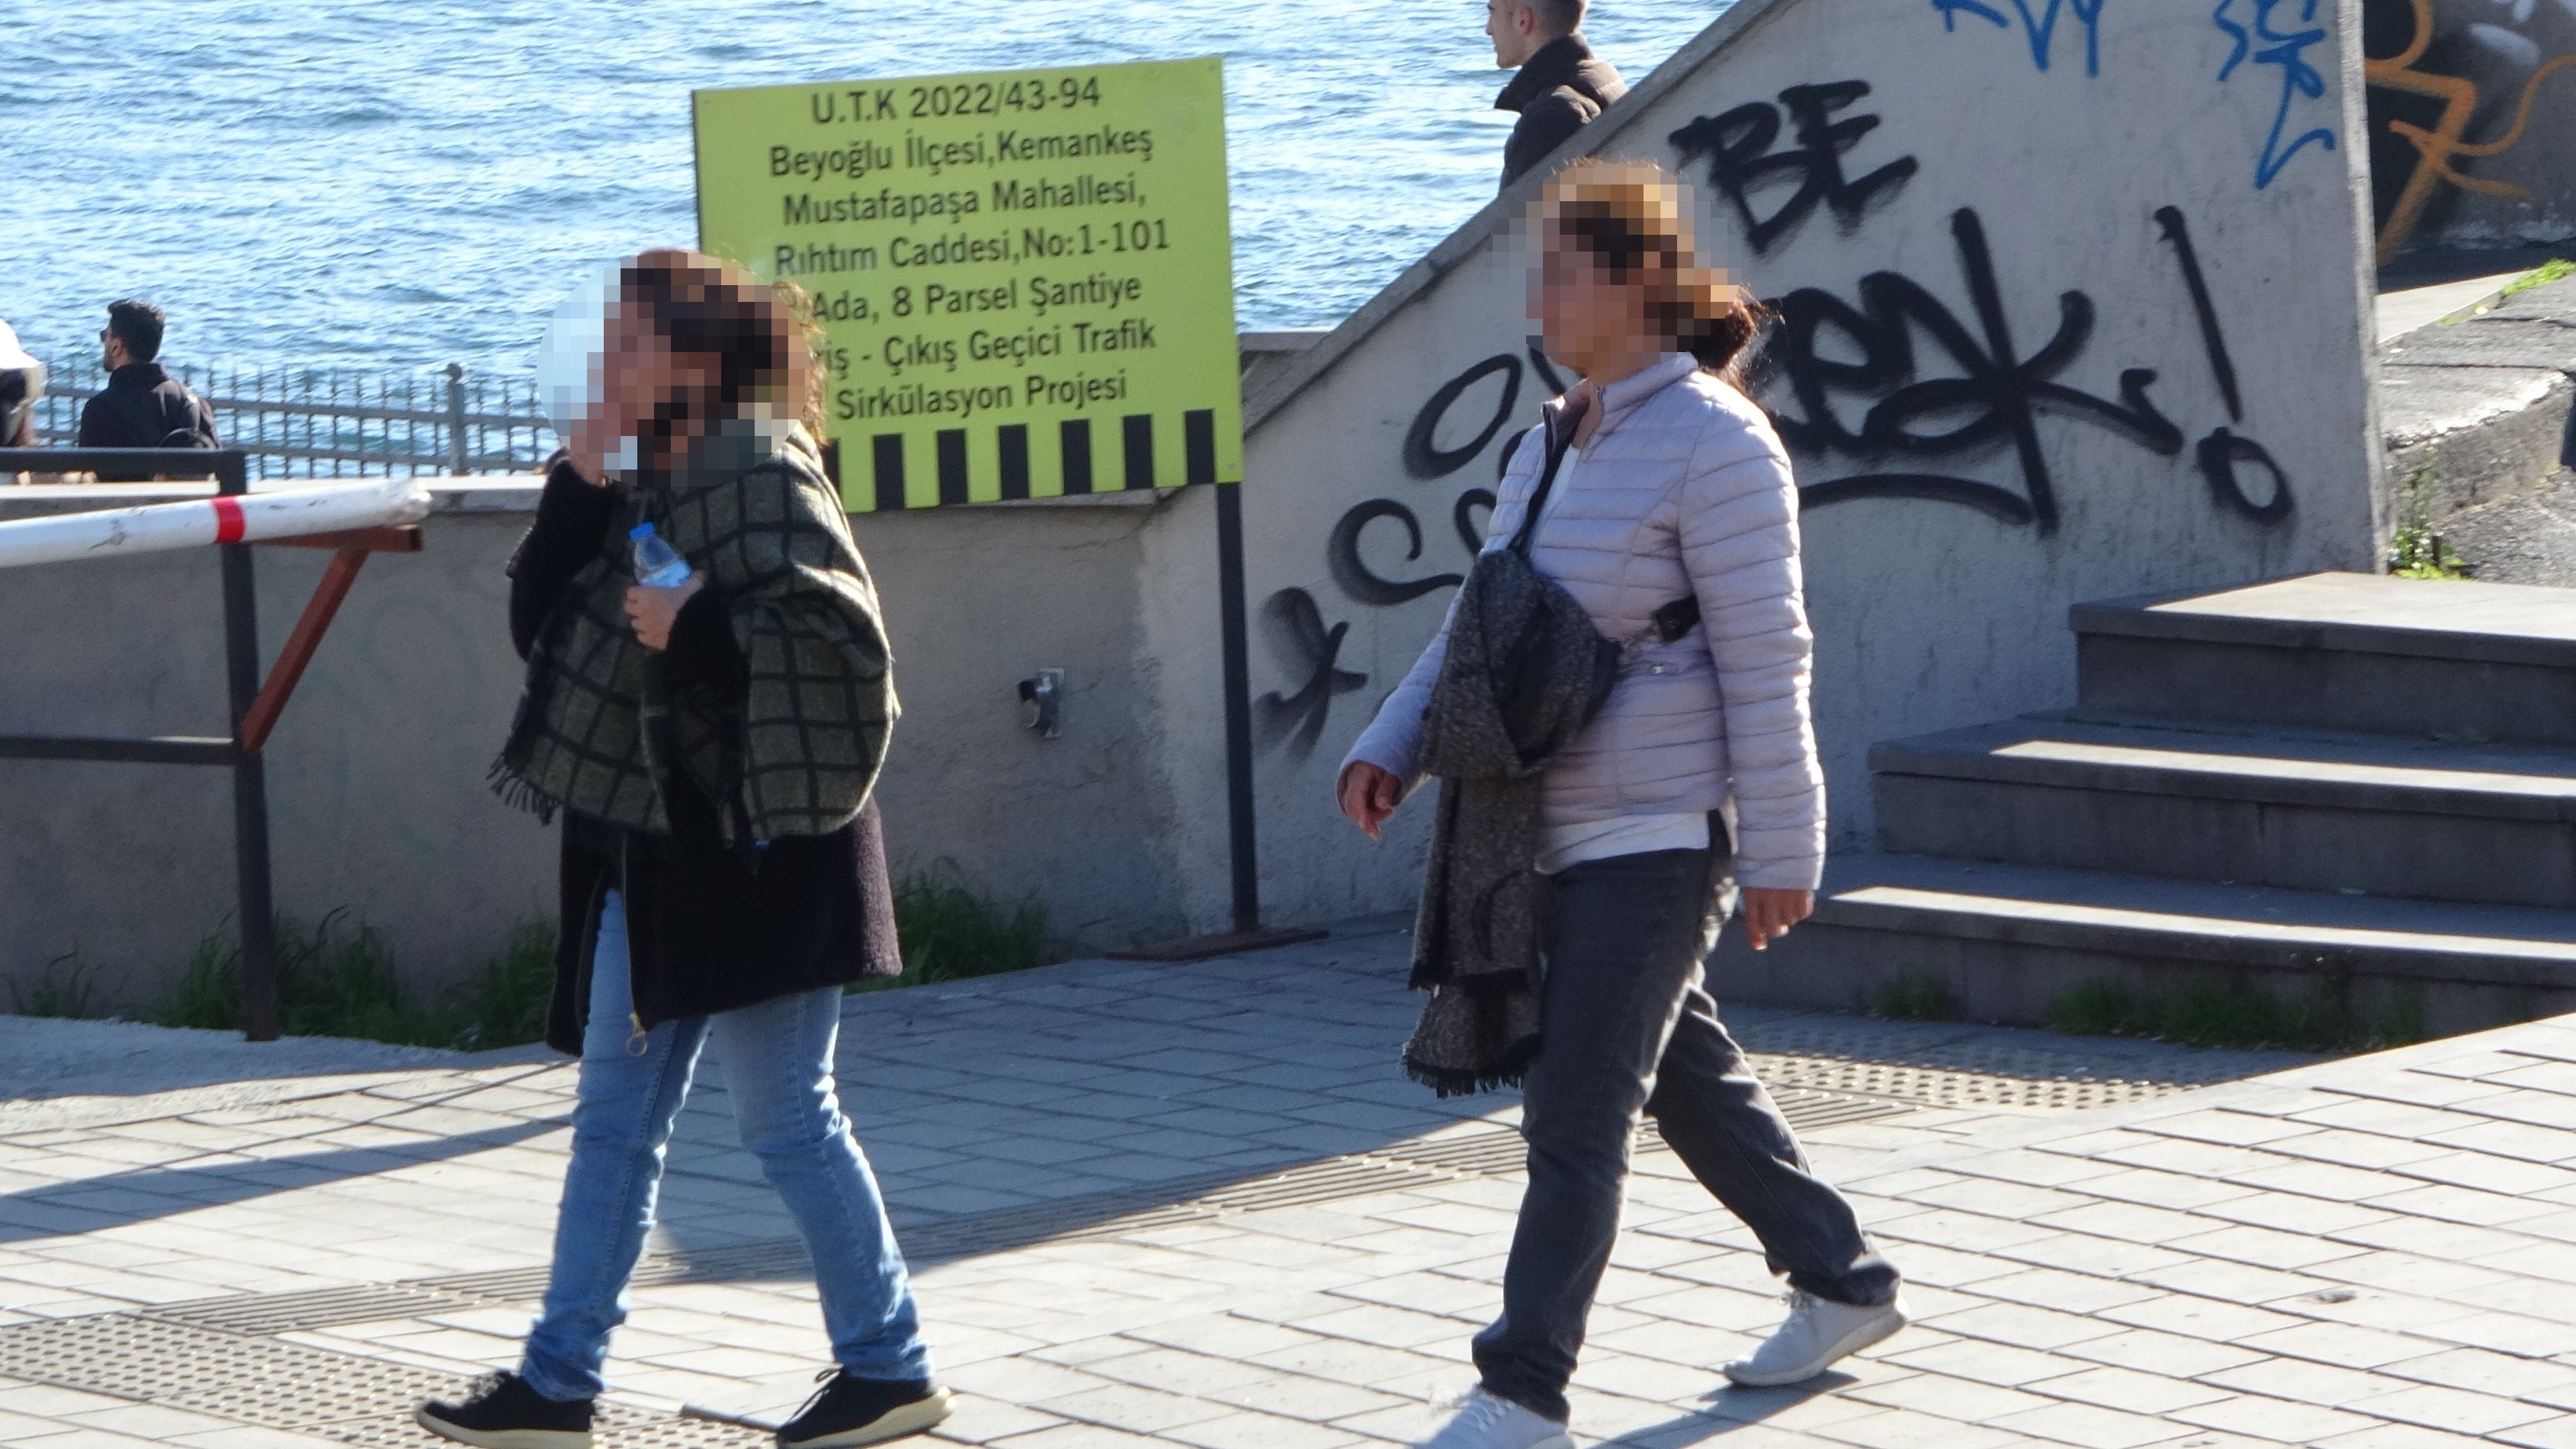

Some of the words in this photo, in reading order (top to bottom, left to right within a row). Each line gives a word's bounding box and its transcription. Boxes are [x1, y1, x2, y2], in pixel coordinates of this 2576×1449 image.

[812, 87, 898, 125] U.T.K
[909, 75, 1103, 119] 2022/43-94
[769, 140, 894, 182] Beyoğlu
[1670, 78, 1919, 254] BE
[783, 188, 980, 226] Mustafapaşa
[991, 172, 1146, 211] Mahallesi,
[774, 242, 877, 275] Rıhtım
[812, 290, 880, 325] Ada,
[891, 285, 914, 318] 8
[925, 278, 1018, 315] Parsel
[1029, 272, 1142, 317] Şantiye
[883, 334, 958, 376] Çıkış
[967, 325, 1061, 367] Geçici
[1072, 317, 1157, 354] Trafik
[836, 384, 1014, 421] Sirkülasyon
[1025, 368, 1127, 411] Projesi
